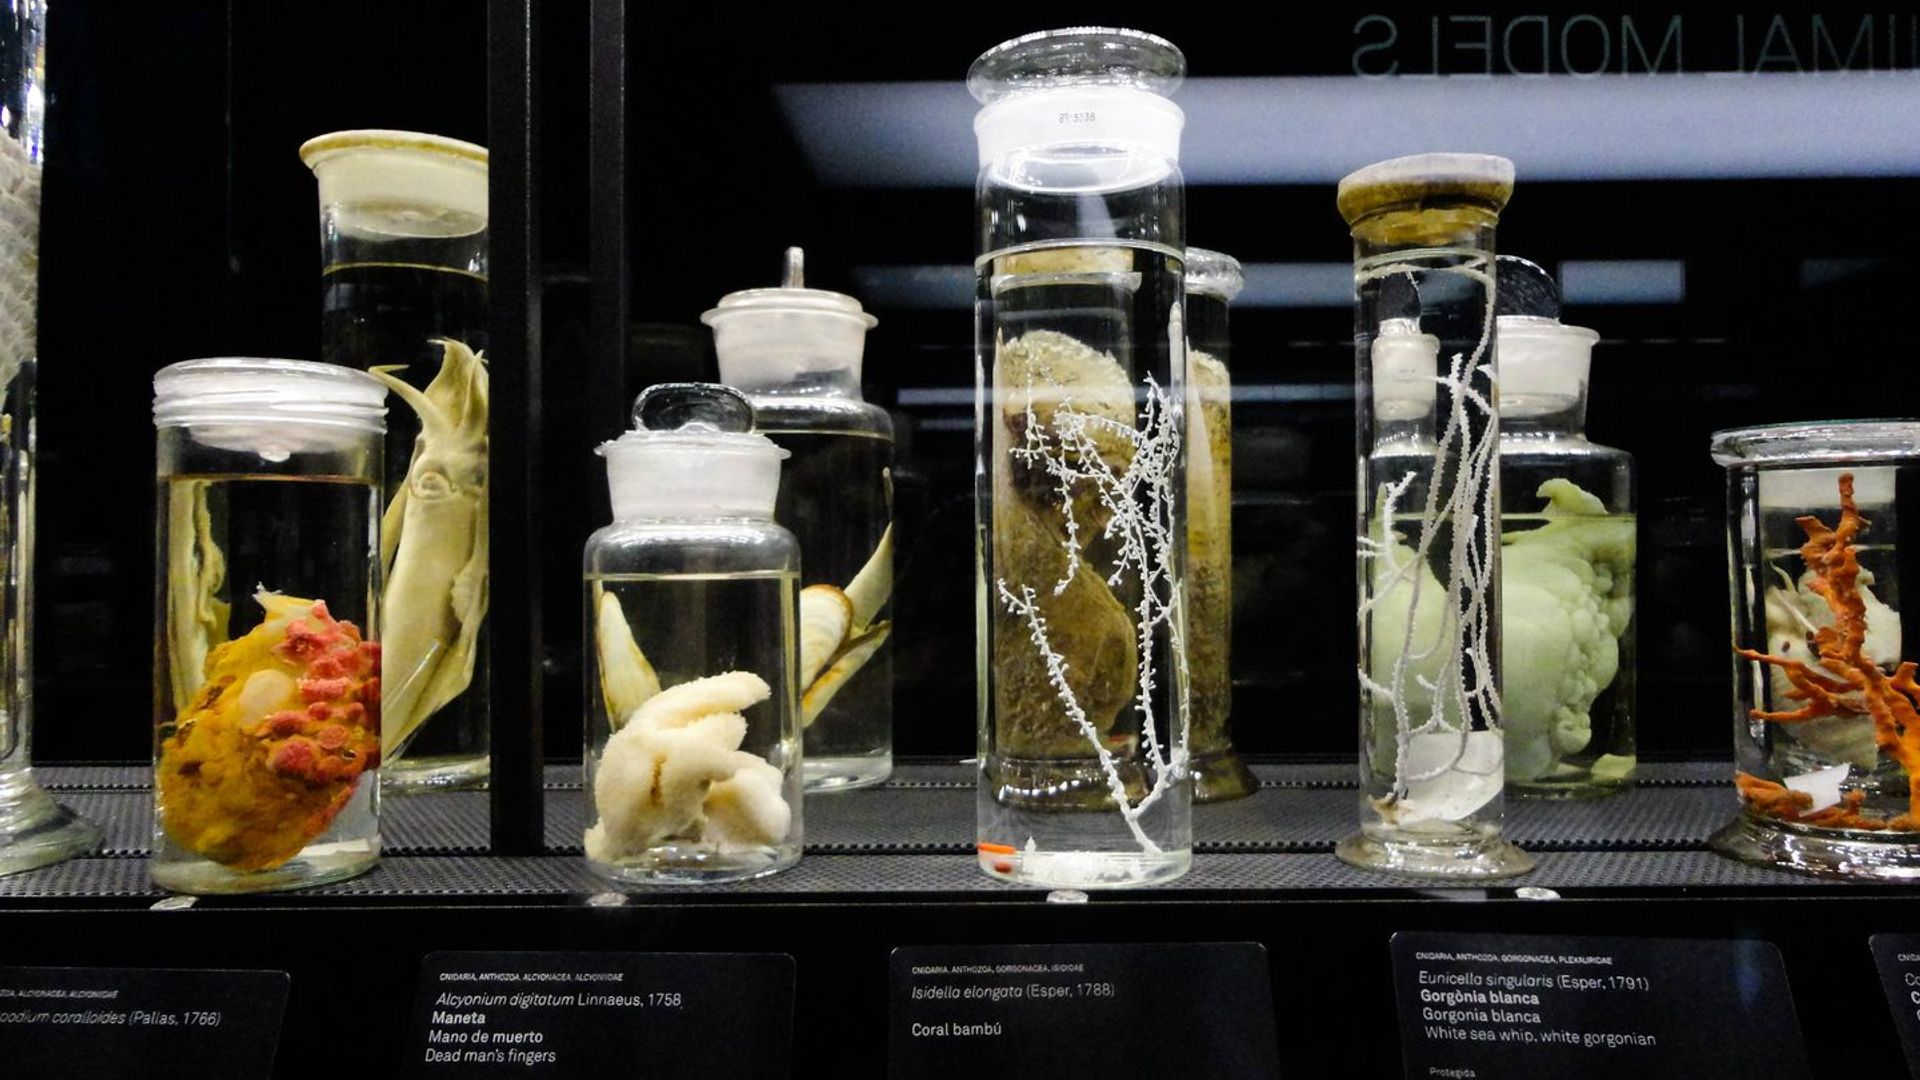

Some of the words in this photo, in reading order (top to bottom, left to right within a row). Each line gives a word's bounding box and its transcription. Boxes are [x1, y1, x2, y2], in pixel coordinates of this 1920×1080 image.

[1418, 971, 1483, 986] Eunicella
[1485, 972, 1553, 990] singularis
[1557, 974, 1606, 992] (Esper,
[1608, 976, 1650, 991] 1791)
[436, 992, 507, 1009] Alcyonium
[510, 992, 574, 1009] digitatum
[578, 992, 644, 1008] Linnaeus,
[911, 986, 960, 999] Isidella
[963, 985, 1023, 1001] elongata
[1026, 984, 1073, 999] (Esper,
[1077, 983, 1115, 998] 1788)
[1420, 989, 1487, 1006] Gorgònia
[1490, 990, 1540, 1005] blanca
[51, 1009, 126, 1024] coralloides
[128, 1010, 179, 1026] (Pallas,
[183, 1012, 222, 1027] 1766)
[432, 1011, 486, 1024] Maneta
[1422, 1007, 1488, 1024] Gorgonia
[1492, 1008, 1541, 1023] blanca
[428, 1030, 468, 1043] Mano
[471, 1030, 489, 1043] de
[492, 1030, 543, 1043] muerto
[911, 1022, 949, 1036] Coral
[953, 1022, 1002, 1036] bambú
[1425, 1026, 1467, 1040] White
[1470, 1029, 1496, 1042] sea
[1499, 1028, 1538, 1043] whip,
[1540, 1030, 1580, 1044] white
[1583, 1033, 1656, 1048] gorgonian
[425, 1048, 461, 1062] Dead
[464, 1048, 504, 1062] man's
[508, 1048, 556, 1066] fingers
